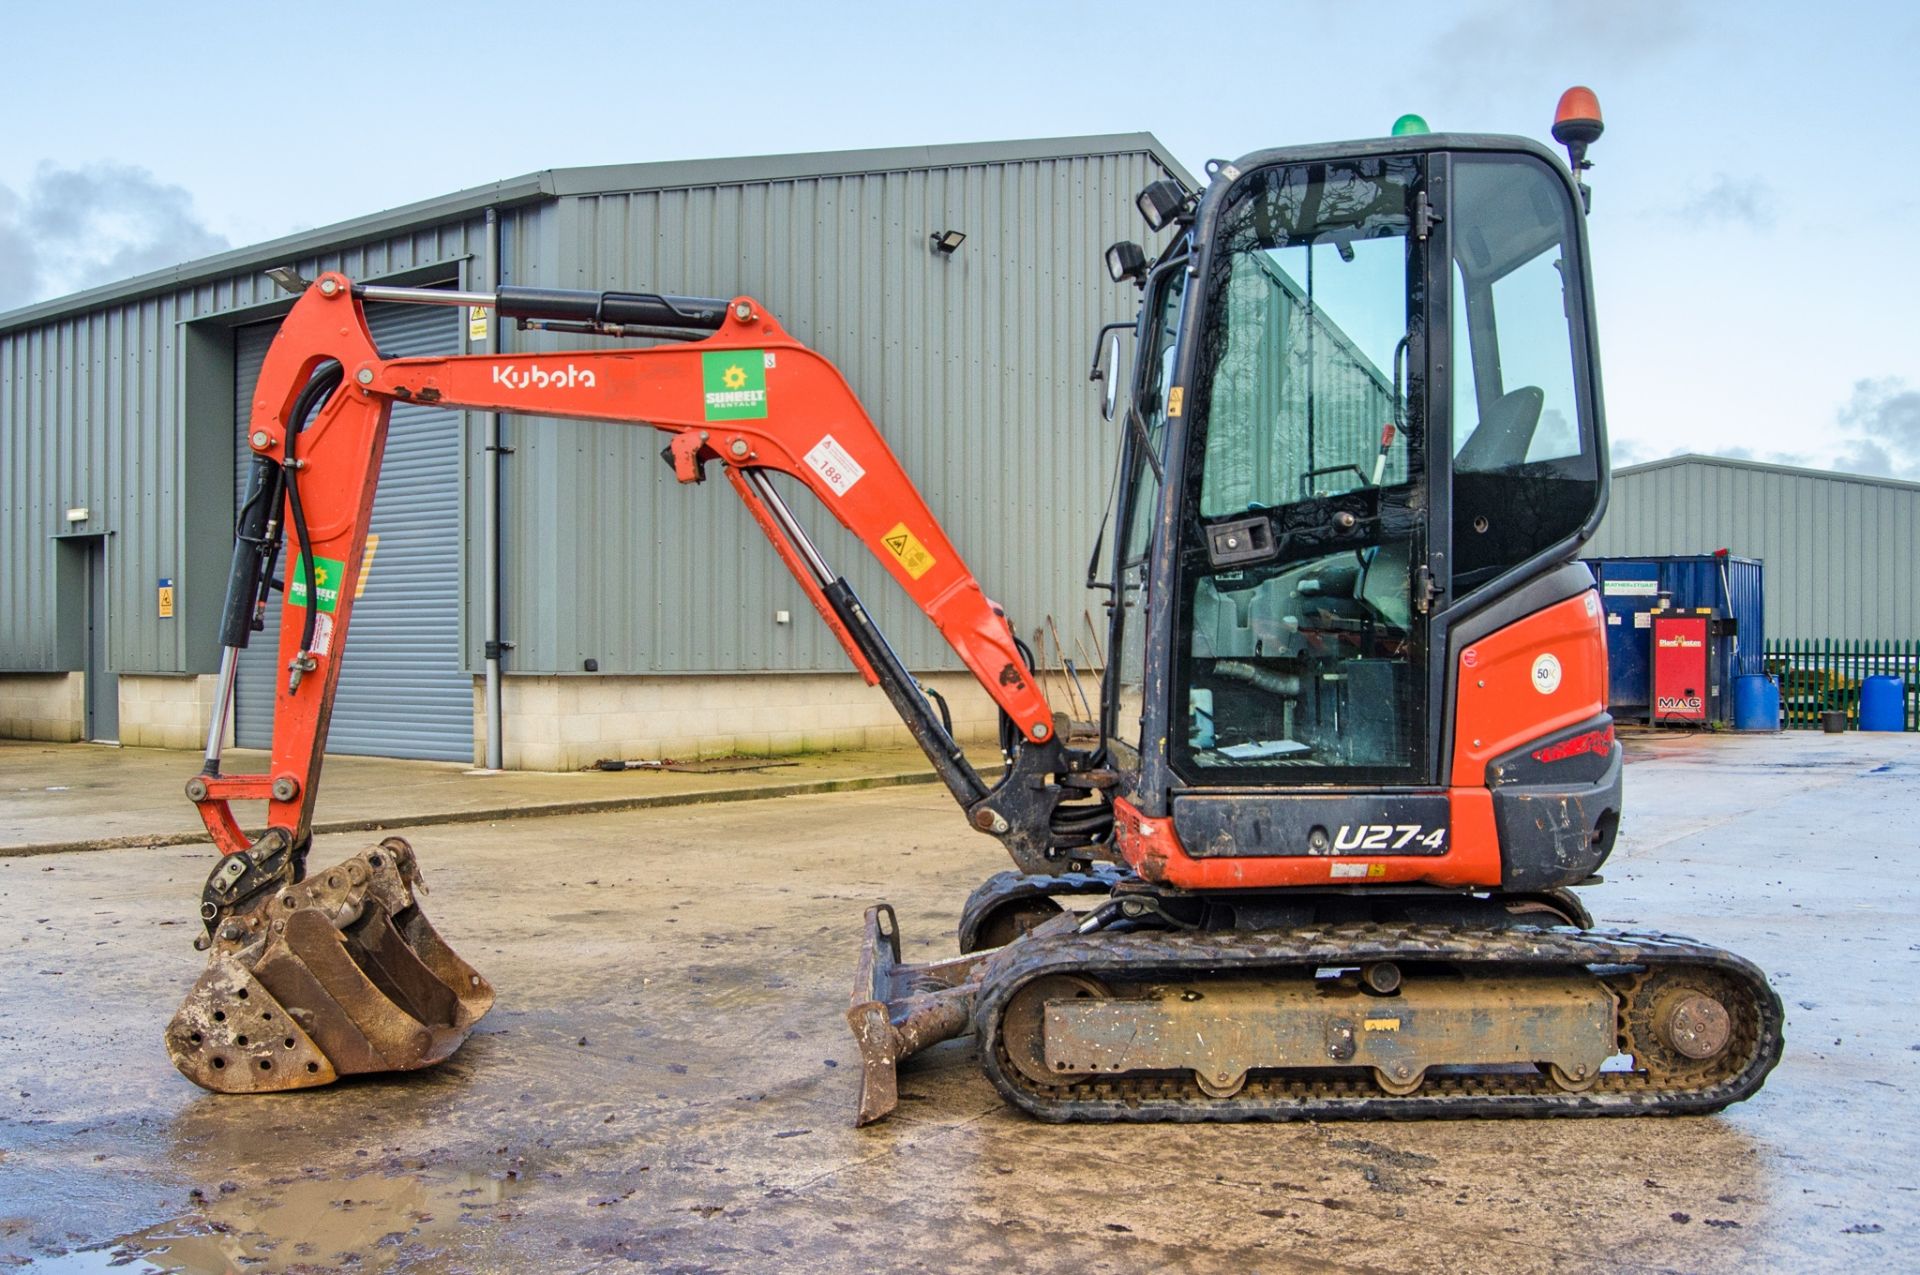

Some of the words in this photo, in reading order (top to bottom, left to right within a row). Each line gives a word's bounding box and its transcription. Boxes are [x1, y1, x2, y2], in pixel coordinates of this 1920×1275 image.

[492, 363, 596, 389] Kubota
[705, 390, 765, 405] SUNBELT
[713, 400, 757, 409] RENTALS
[820, 460, 842, 484] 188
[1658, 697, 1702, 709] MAC
[1334, 825, 1446, 850] U27-4
